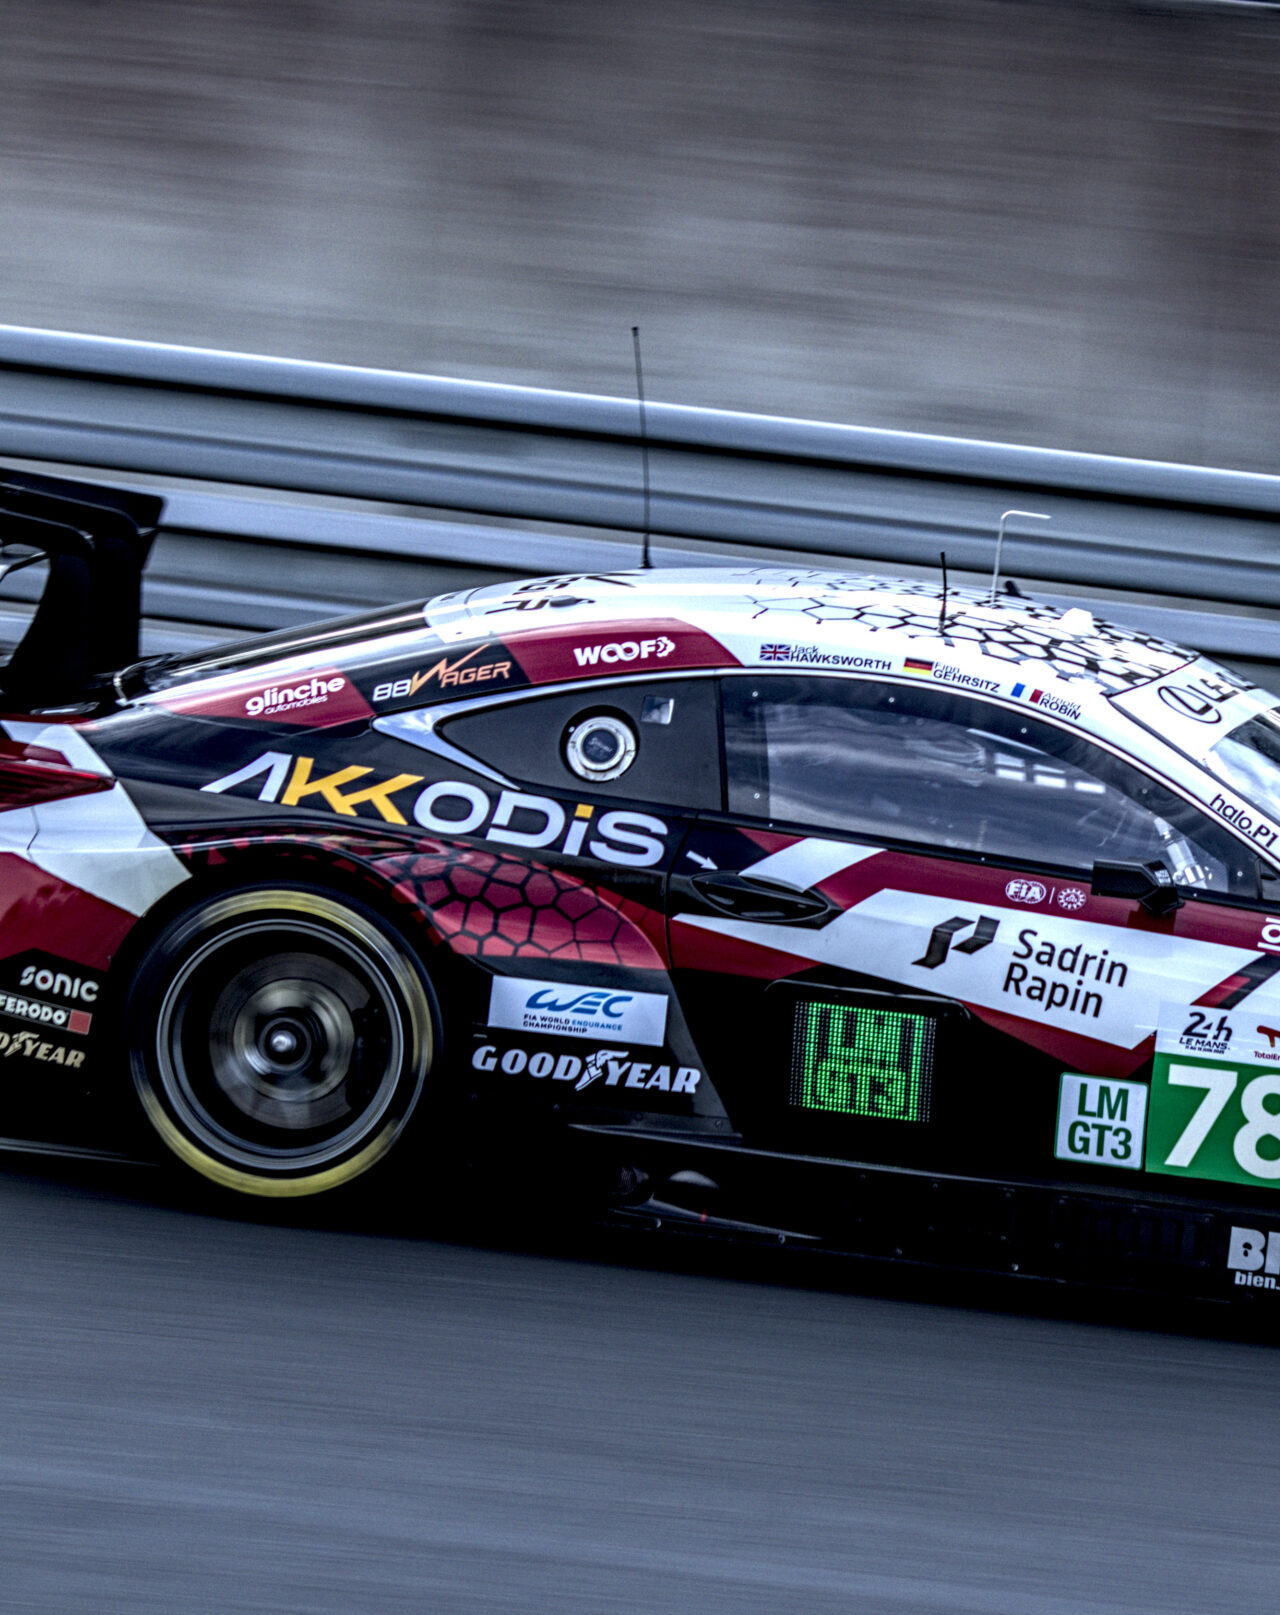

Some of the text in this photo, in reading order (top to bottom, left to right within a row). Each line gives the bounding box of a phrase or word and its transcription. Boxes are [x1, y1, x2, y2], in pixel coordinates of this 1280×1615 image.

[573, 639, 657, 666] WOOF
[790, 644, 819, 655] Jack
[790, 653, 892, 671] HAWKSWORTH
[933, 661, 960, 674] Finn
[933, 670, 1001, 693] GEHRSITZ
[245, 677, 346, 716] glinche
[264, 694, 328, 715] automobiles
[1041, 692, 1081, 711] Arnold
[1040, 698, 1081, 721] ROBIN
[1209, 793, 1279, 848] halo.P1
[1007, 883, 1043, 901] FIA
[1012, 928, 1128, 988] Sadrin
[19, 965, 99, 1002] SONIC
[1003, 962, 1103, 1018] Rapin
[525, 988, 633, 1018] WEC
[522, 1020, 588, 1034] CHAMPIONSHIP
[523, 1013, 623, 1031] FIA WORLD ENDURANCE
[1181, 1011, 1233, 1042] 24h
[1179, 1036, 1194, 1046] LE
[1077, 1082, 1129, 1122] LM
[1067, 1120, 1132, 1160] GT3
